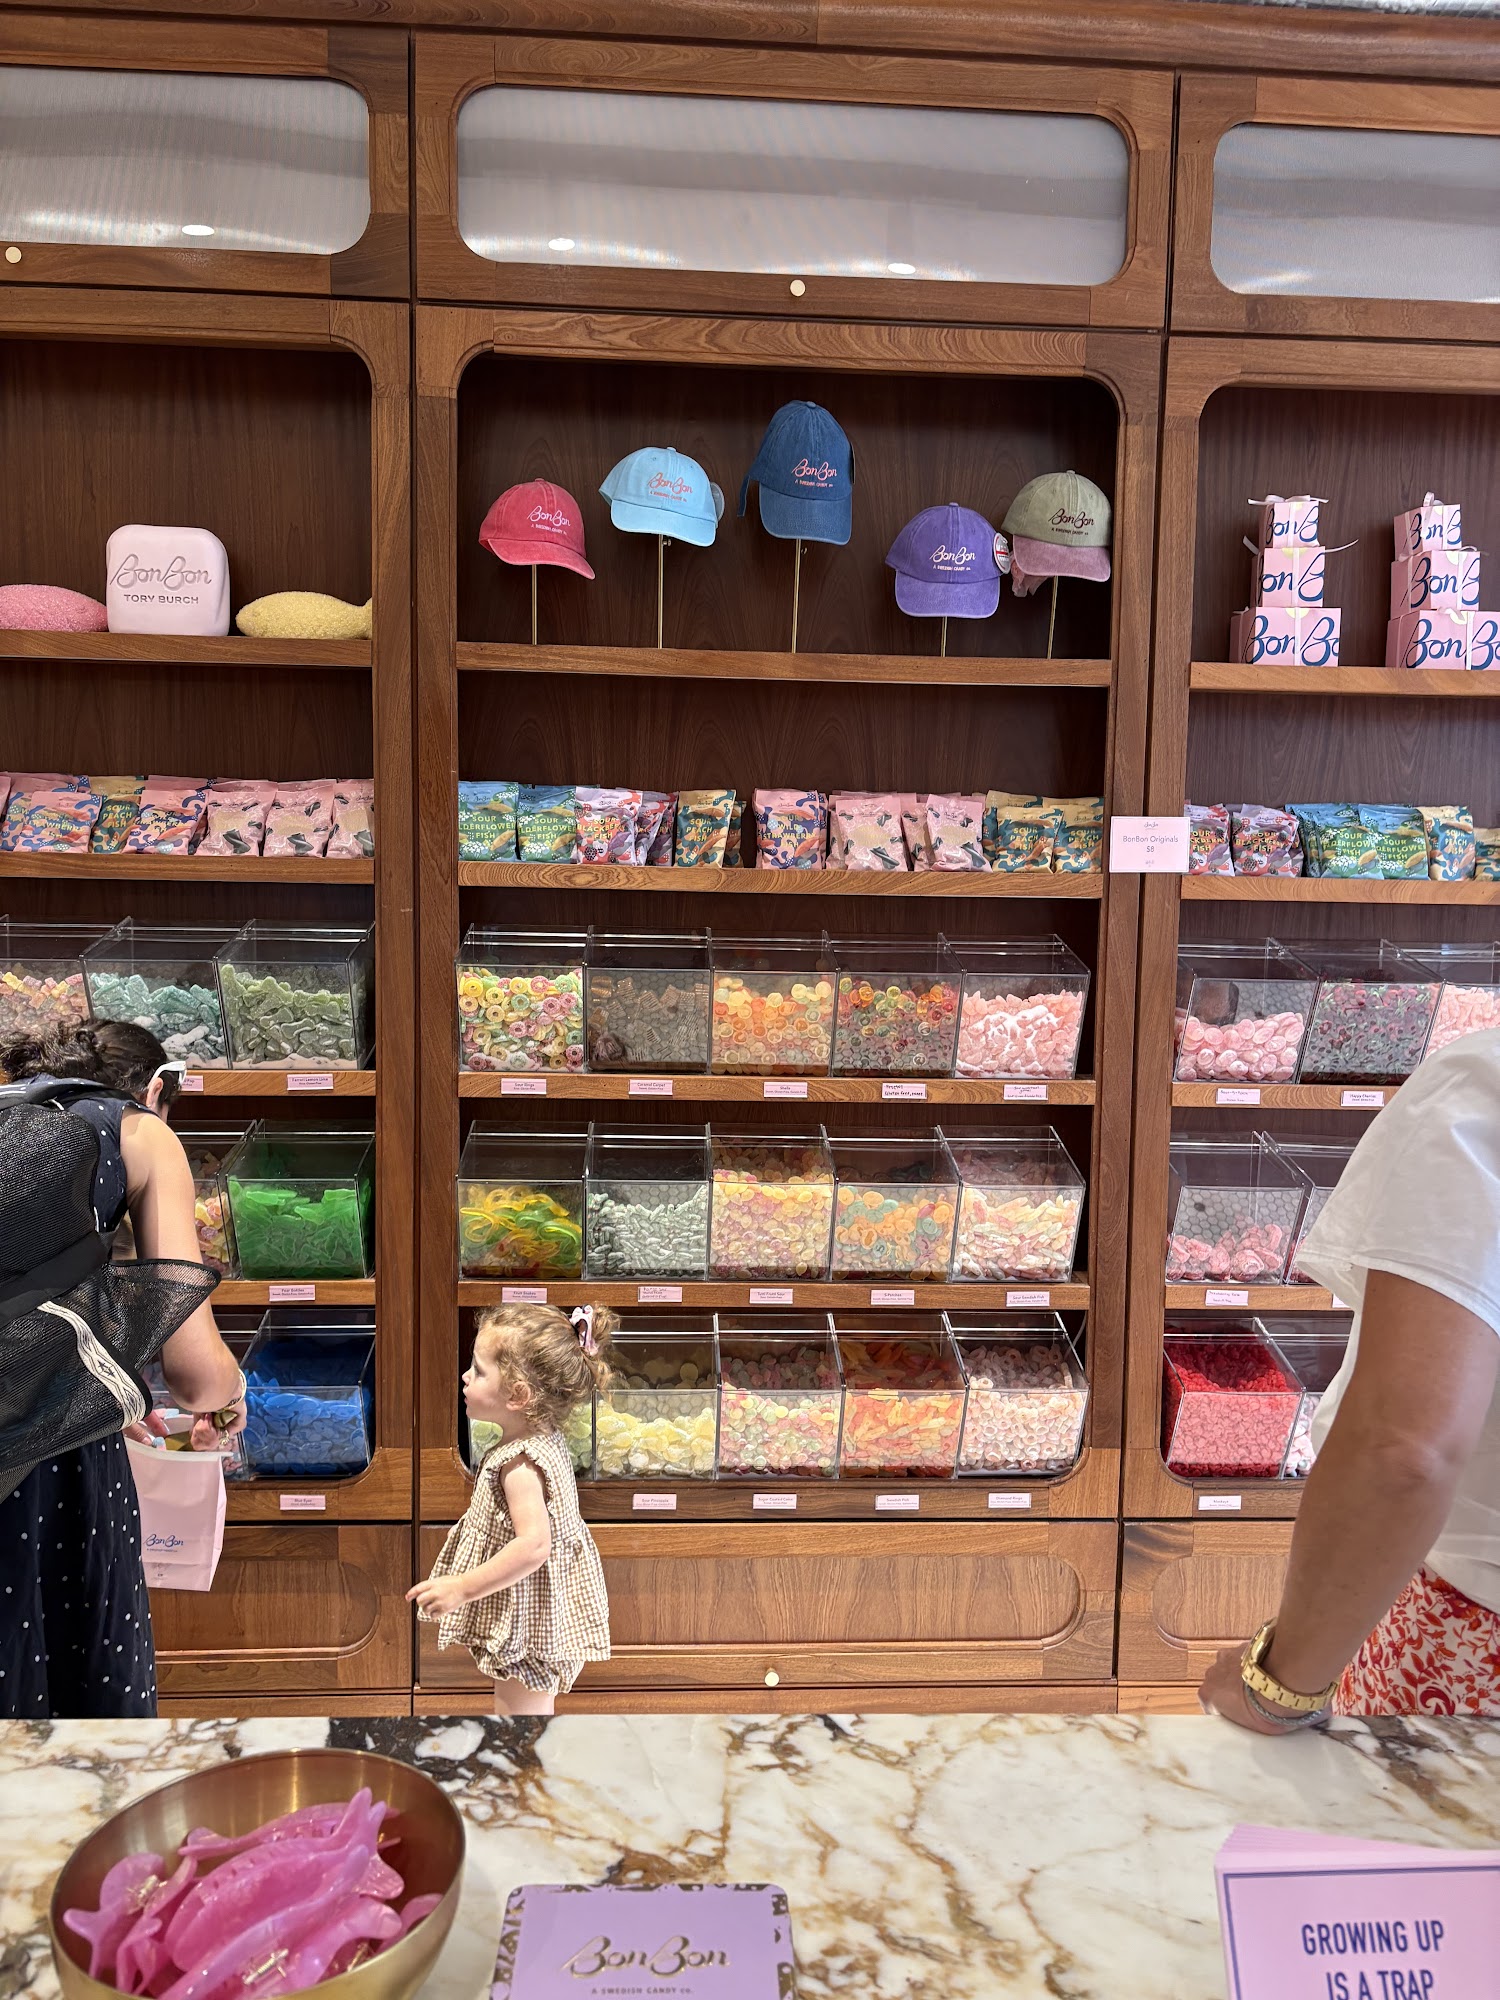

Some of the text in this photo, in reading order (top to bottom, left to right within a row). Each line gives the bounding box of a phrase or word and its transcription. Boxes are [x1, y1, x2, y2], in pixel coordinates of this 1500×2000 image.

[791, 458, 837, 481] BonBon
[527, 505, 571, 526] BonBon
[1048, 508, 1094, 528] BonBon
[929, 545, 976, 565] BonBon
[110, 553, 212, 591] BonBon
[124, 594, 199, 605] TORY BURCH
[106, 803, 130, 812] SOUR
[103, 811, 133, 819] PEACH
[594, 817, 616, 825] SOUR
[595, 832, 613, 840] FISH
[1010, 834, 1038, 842] PEACH
[1069, 834, 1099, 843] PEACH
[1123, 835, 1179, 845] BonBon Originals
[1384, 838, 1407, 846] SOUR
[1254, 844, 1273, 852] FISH
[143, 1533, 184, 1548] BonBon
[1301, 1919, 1445, 1956] GROWING UP
[561, 1935, 730, 1979] BonBon
[1325, 1968, 1434, 2000] IS A TRAP
[591, 1987, 598, 1995] A
[600, 1986, 643, 1995] SWEDISH
[646, 1986, 677, 1995] CANDY
